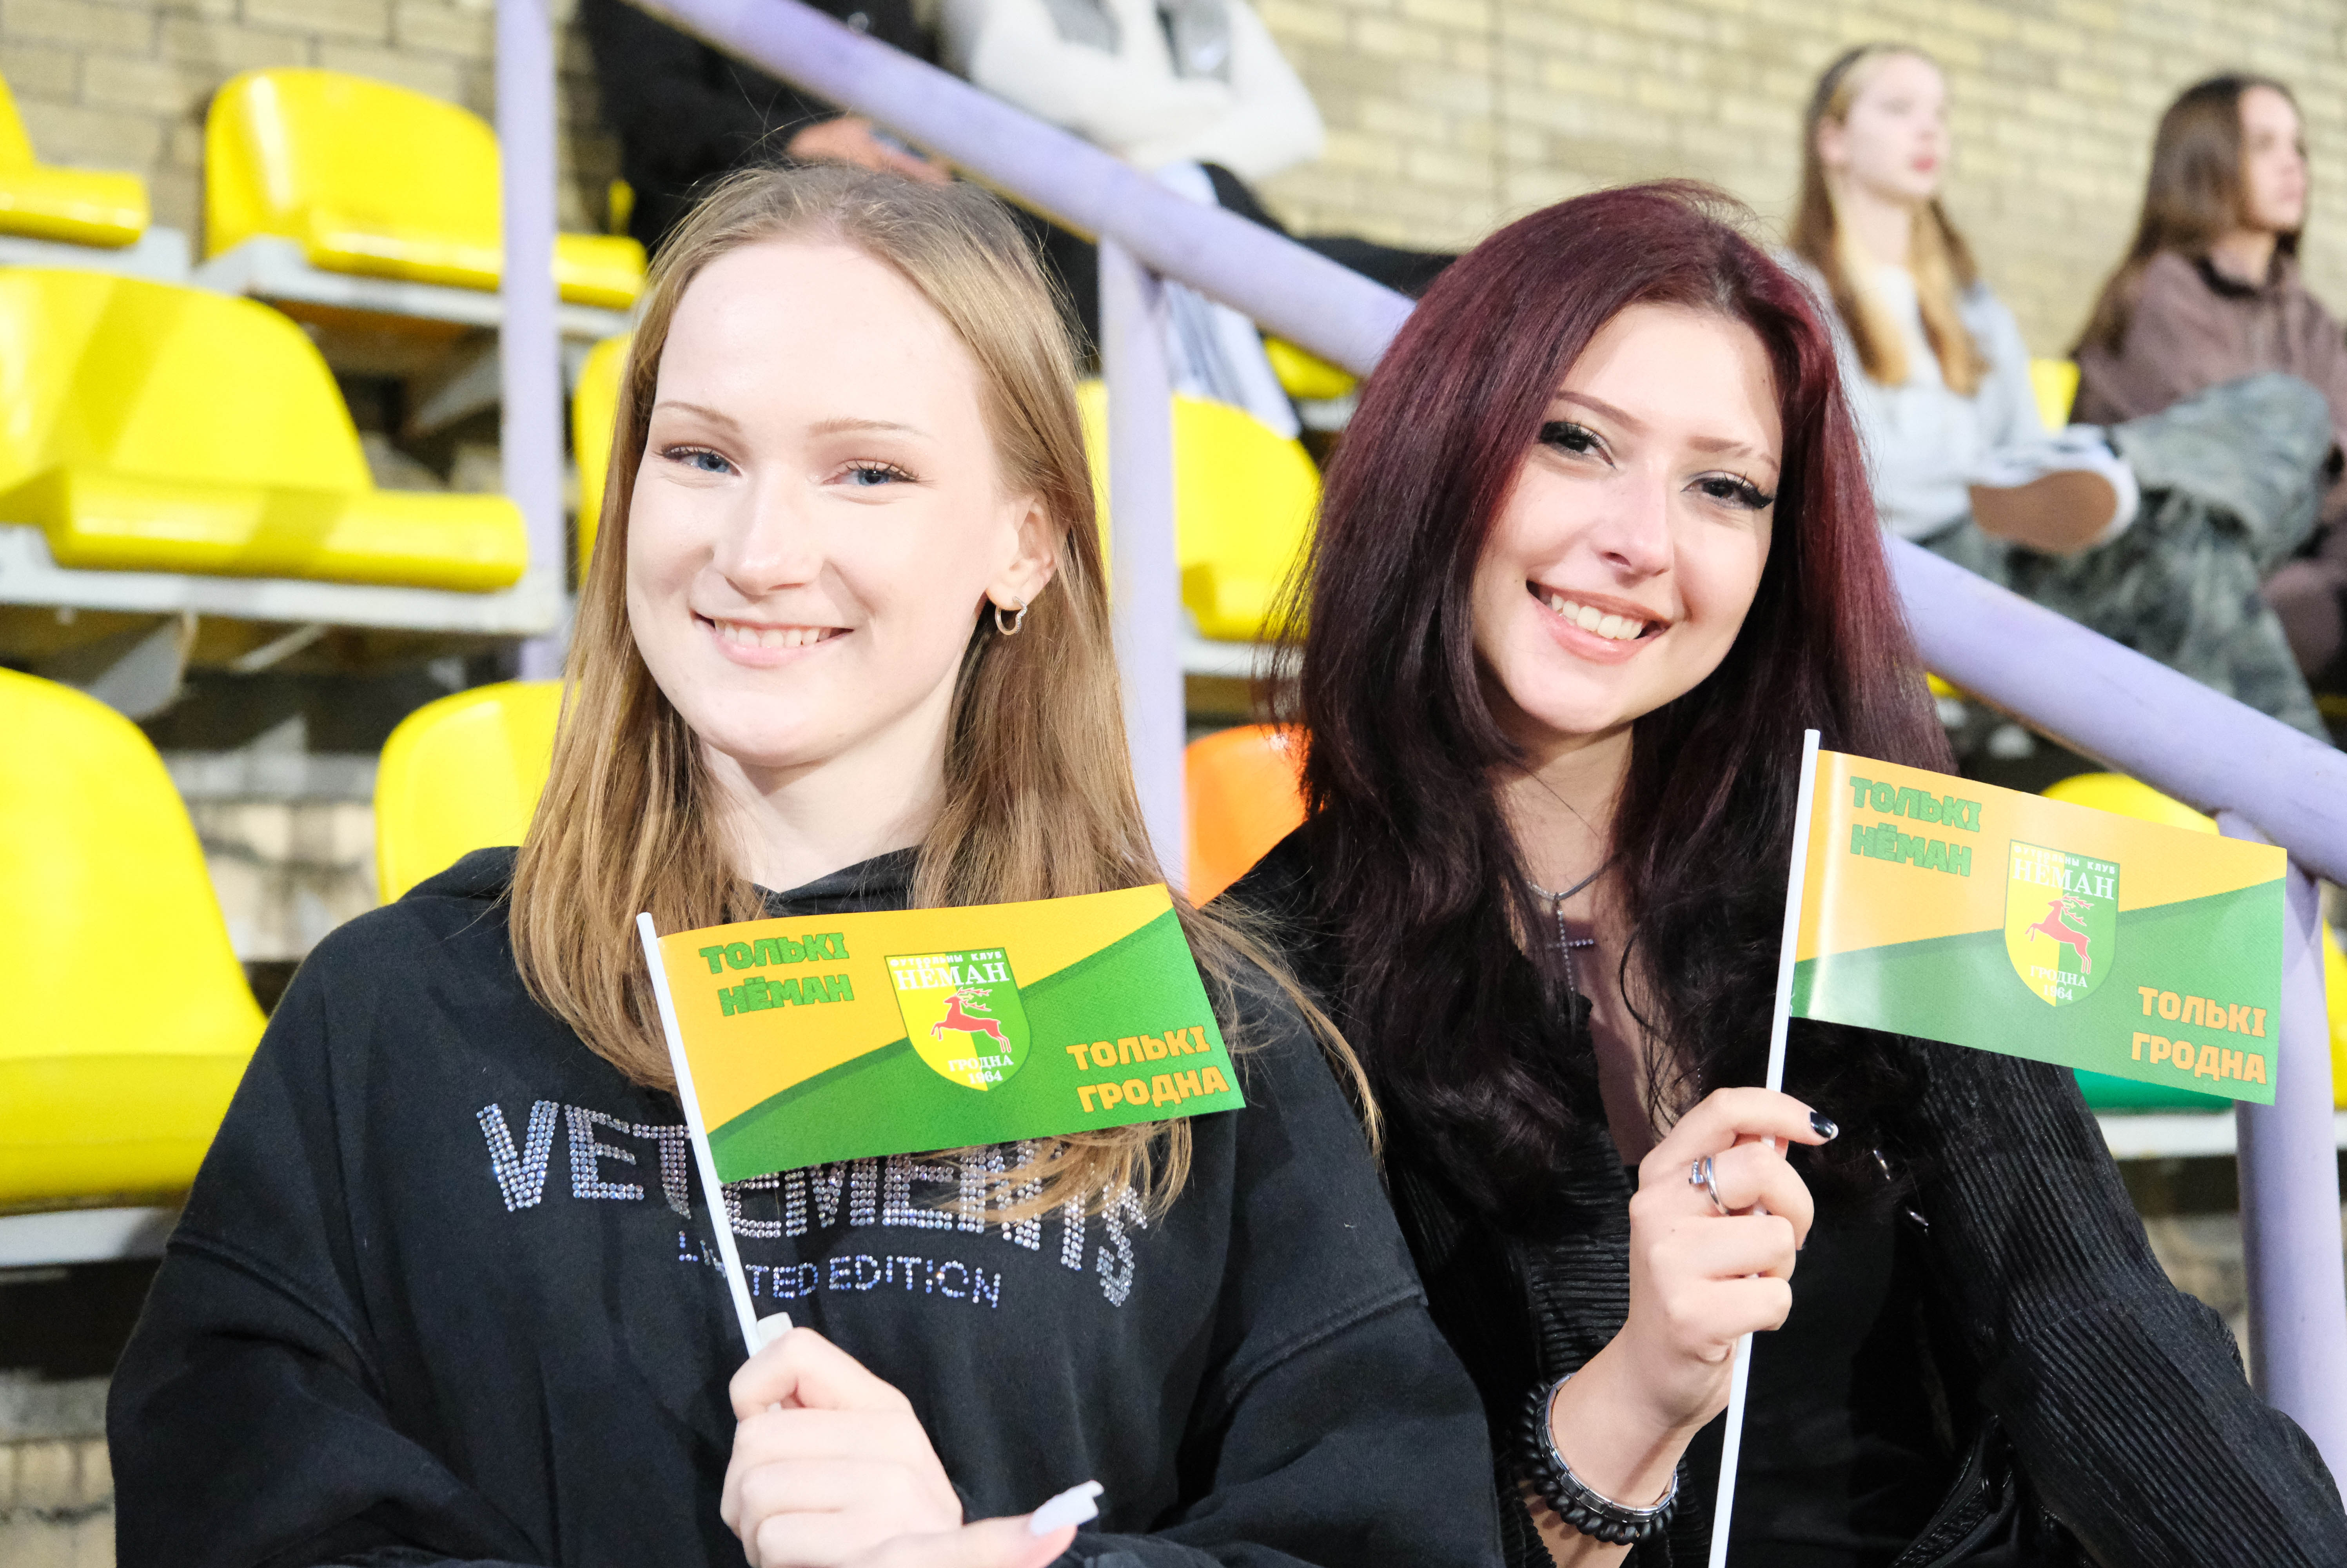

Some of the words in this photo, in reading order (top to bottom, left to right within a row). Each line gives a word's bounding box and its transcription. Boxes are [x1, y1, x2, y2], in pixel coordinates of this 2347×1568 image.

[1850, 776, 1982, 832] ТОЛЬКІ
[1850, 822, 1972, 877] НЁМАН
[2014, 845, 2079, 866] ФУТБОЛЬНЫ
[2087, 862, 2115, 875] КЛУБ
[2013, 858, 2115, 900] НЁМАН
[699, 932, 849, 974] ТОЛЬКІ
[890, 954, 963, 966] ФУТБОЛЬНЫ
[971, 951, 1002, 962] КЛУБ
[718, 974, 855, 1016] НЁМАН
[894, 962, 1010, 990] НЁМАН
[2030, 965, 2087, 987] ГРОДНА
[2044, 984, 2073, 1000] 1964
[2138, 985, 2267, 1038] ТОЛЬКІ
[948, 1054, 1014, 1071] ГРОДНА
[1065, 1025, 1211, 1070] ТОЛЬКІ
[2132, 1031, 2267, 1085] ГРОДНА
[968, 1070, 1003, 1084] 1964
[1077, 1066, 1230, 1112] ГРОДНА
[679, 1230, 819, 1298] LITED
[829, 1254, 1001, 1308] EDITION
